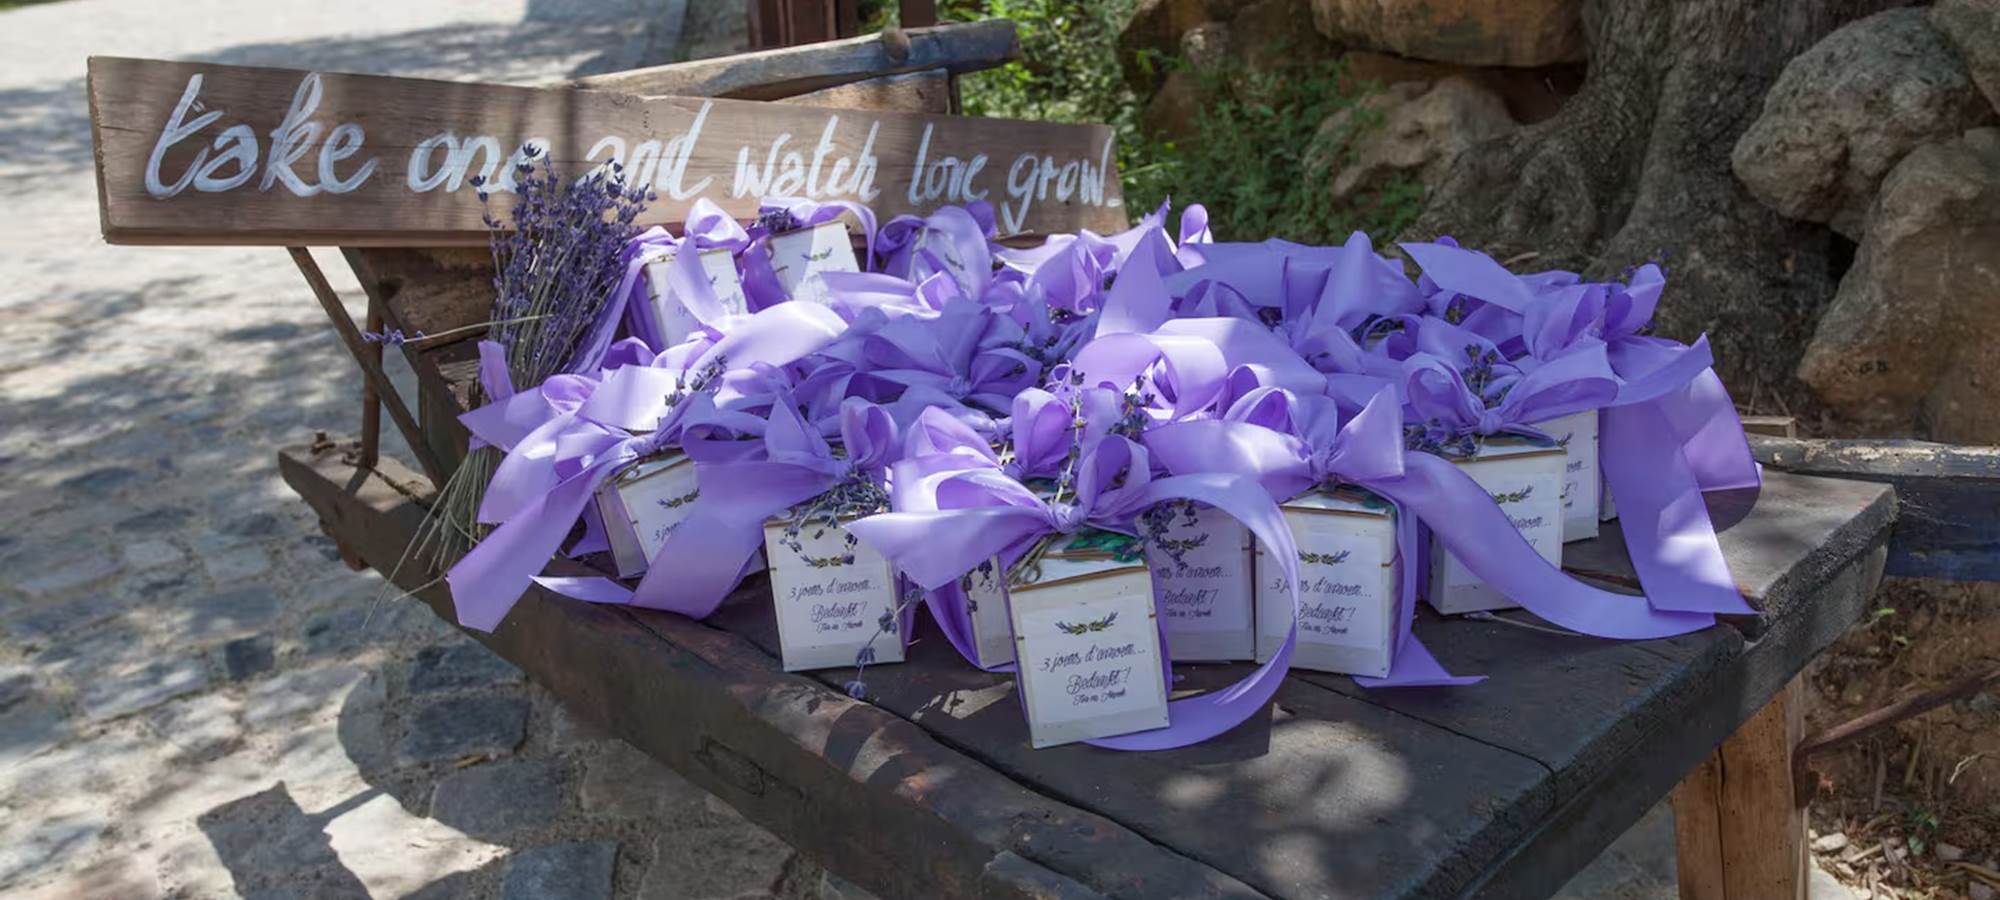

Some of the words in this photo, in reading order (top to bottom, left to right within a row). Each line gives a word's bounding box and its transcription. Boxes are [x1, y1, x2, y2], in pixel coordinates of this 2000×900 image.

[145, 72, 381, 200] take
[407, 129, 552, 194] one
[576, 100, 716, 201] and
[732, 114, 881, 203] watch
[908, 122, 989, 206] love
